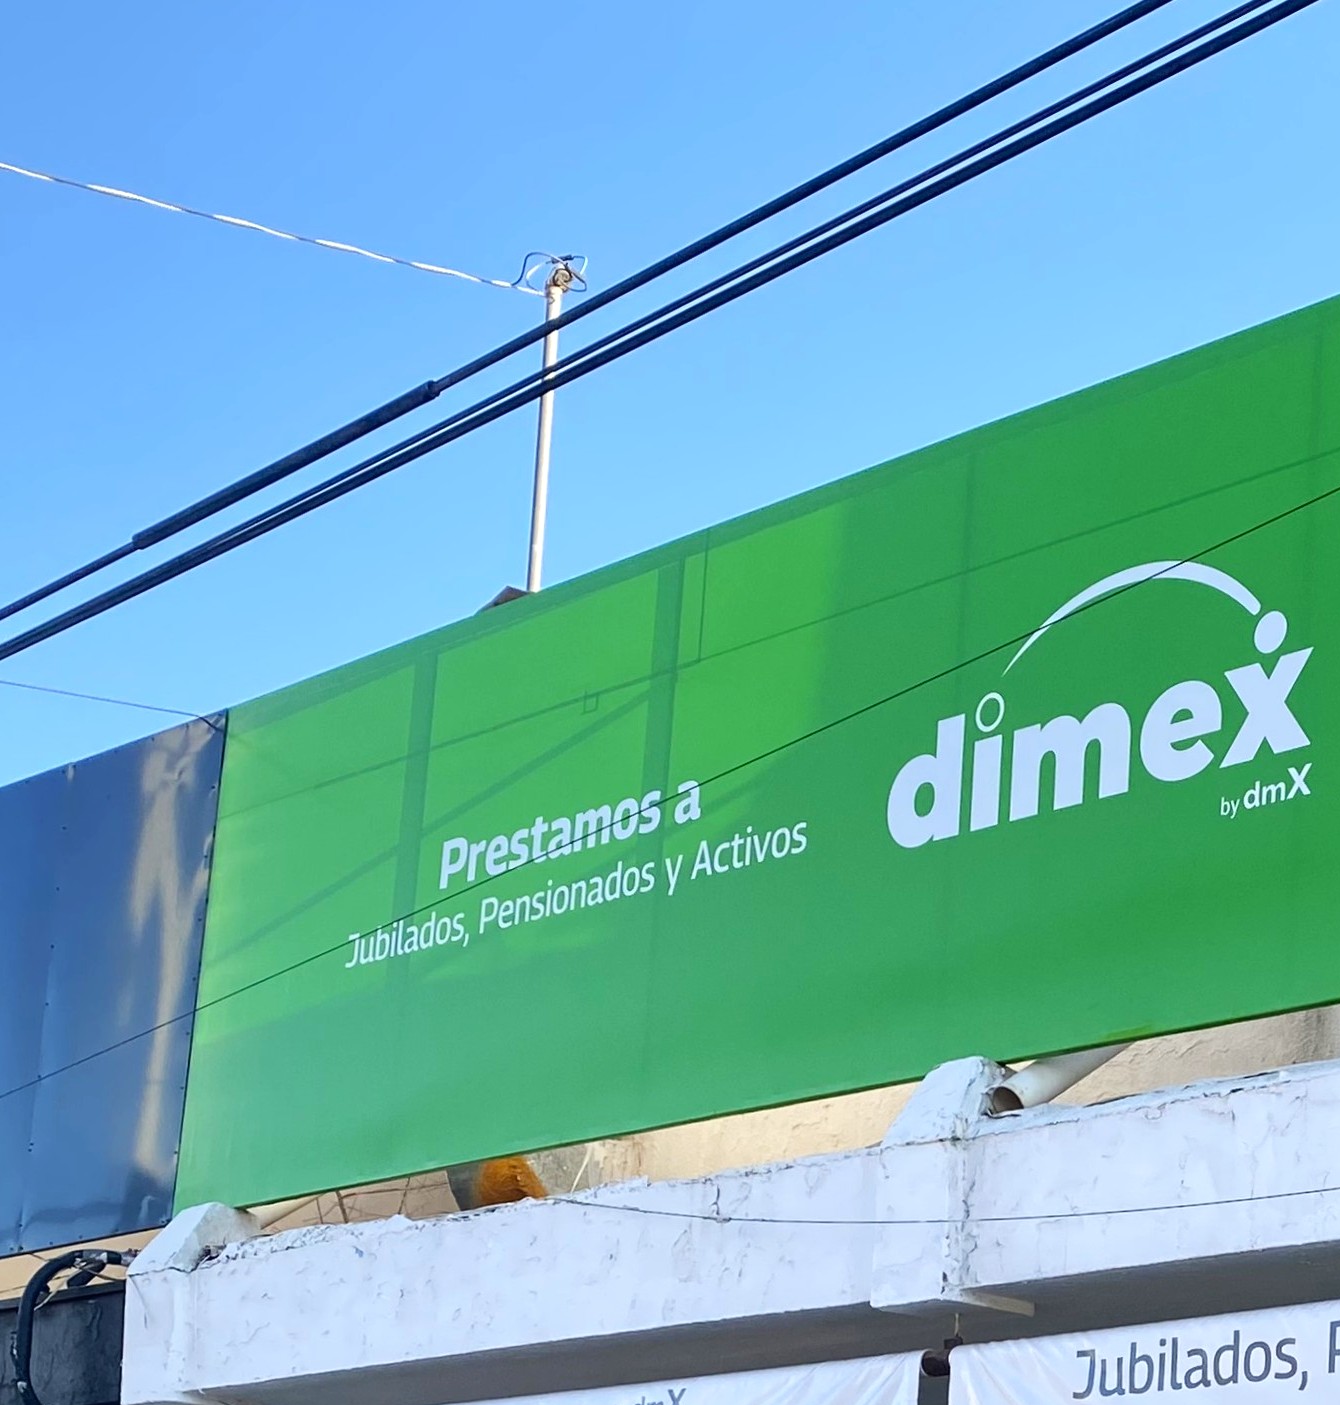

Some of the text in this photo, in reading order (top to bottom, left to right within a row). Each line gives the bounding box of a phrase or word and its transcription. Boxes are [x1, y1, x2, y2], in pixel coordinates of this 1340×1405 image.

[886, 610, 1314, 848] dimex
[439, 779, 701, 889] Prestamos a
[1220, 763, 1312, 819] by dmX
[345, 821, 808, 968] Jubilados, Pensionados y Activos
[1073, 1331, 1310, 1400] Jubilados,
